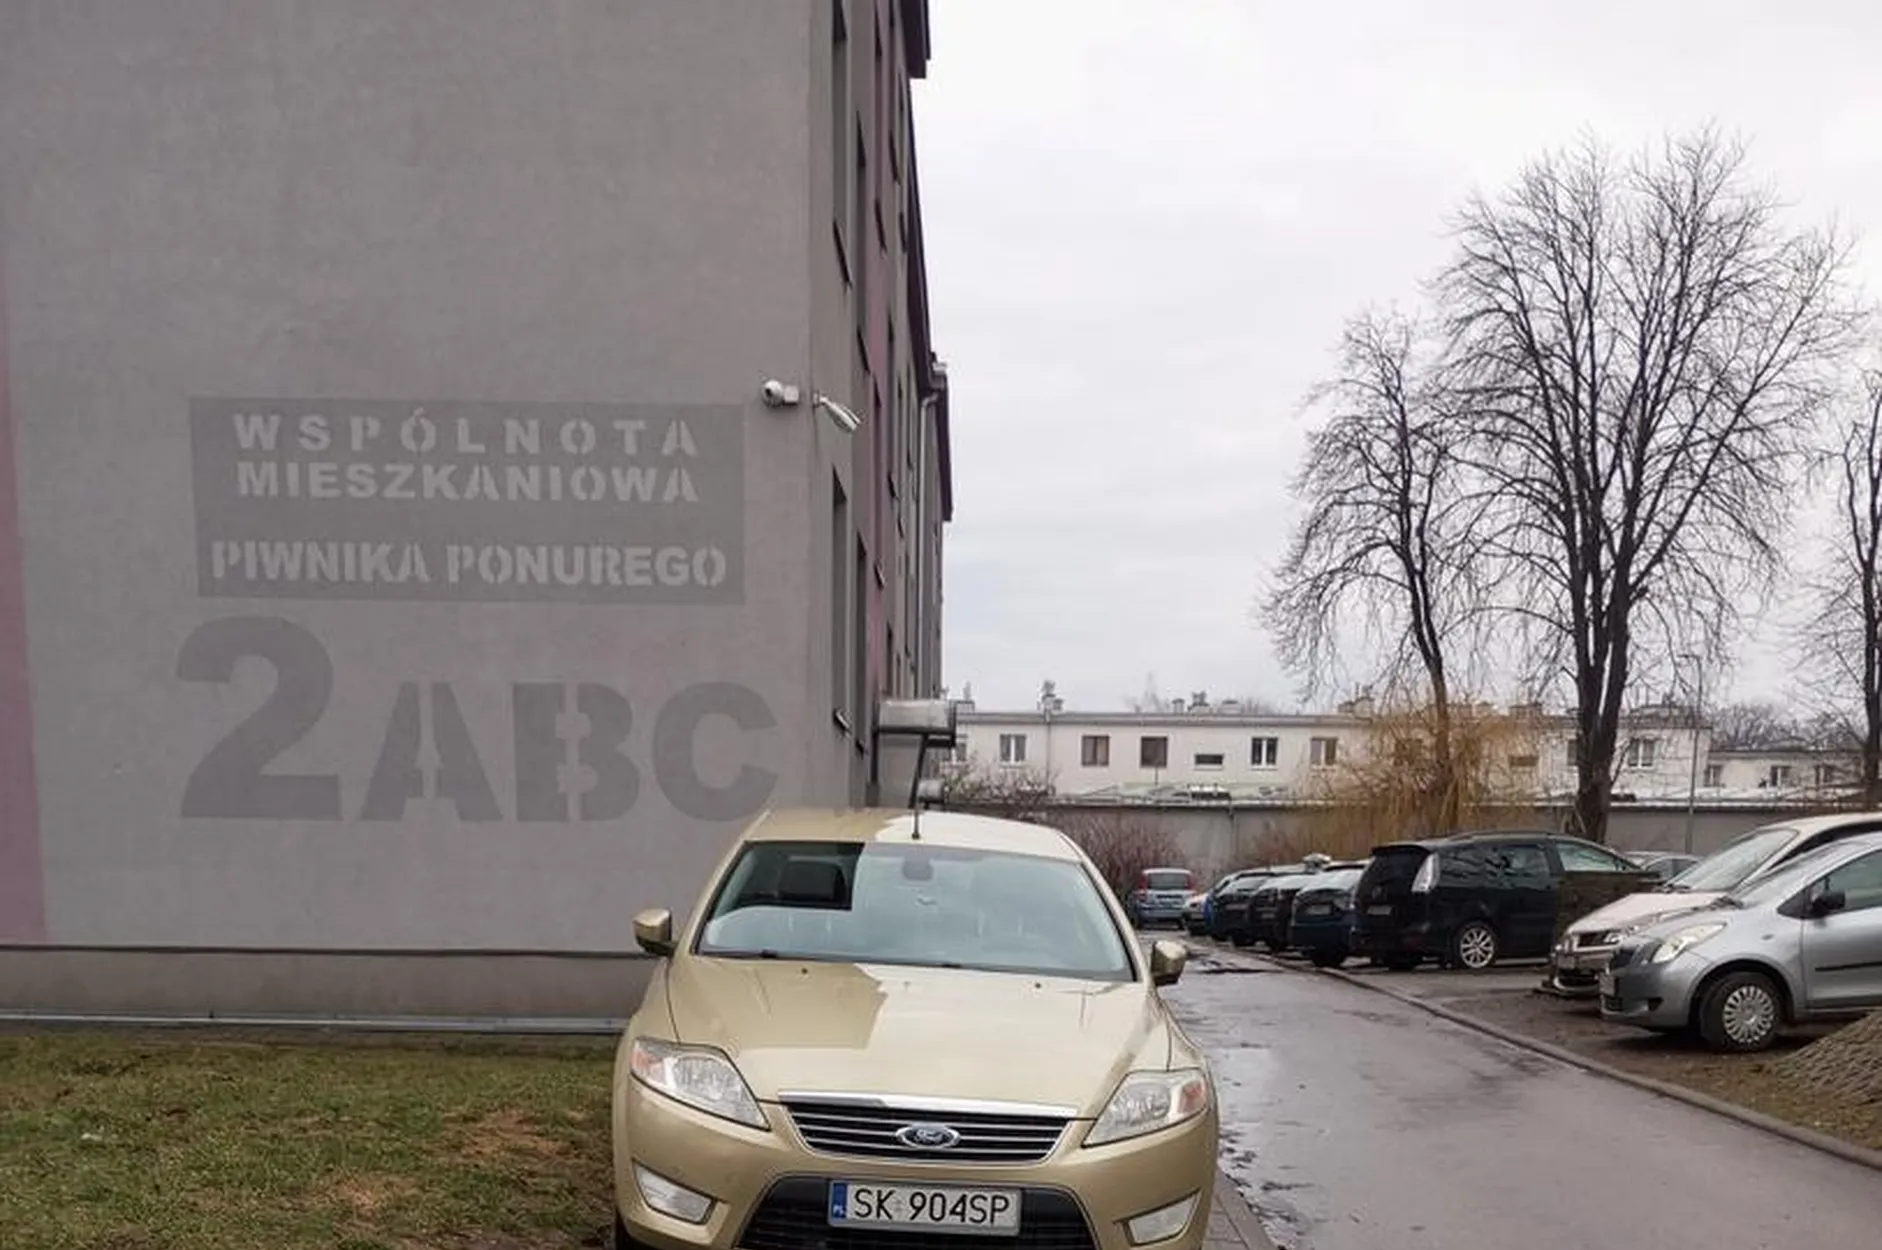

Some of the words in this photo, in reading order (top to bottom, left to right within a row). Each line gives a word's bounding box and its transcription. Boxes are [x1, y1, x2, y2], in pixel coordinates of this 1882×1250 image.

[233, 408, 699, 456] WSPÓLNOTA
[236, 461, 700, 501] MIESZKANIOWA
[211, 541, 430, 583] PIWNIKA
[446, 544, 727, 586] PONUREGO
[854, 1188, 896, 1220] SK
[909, 1191, 1010, 1224] 904SP
